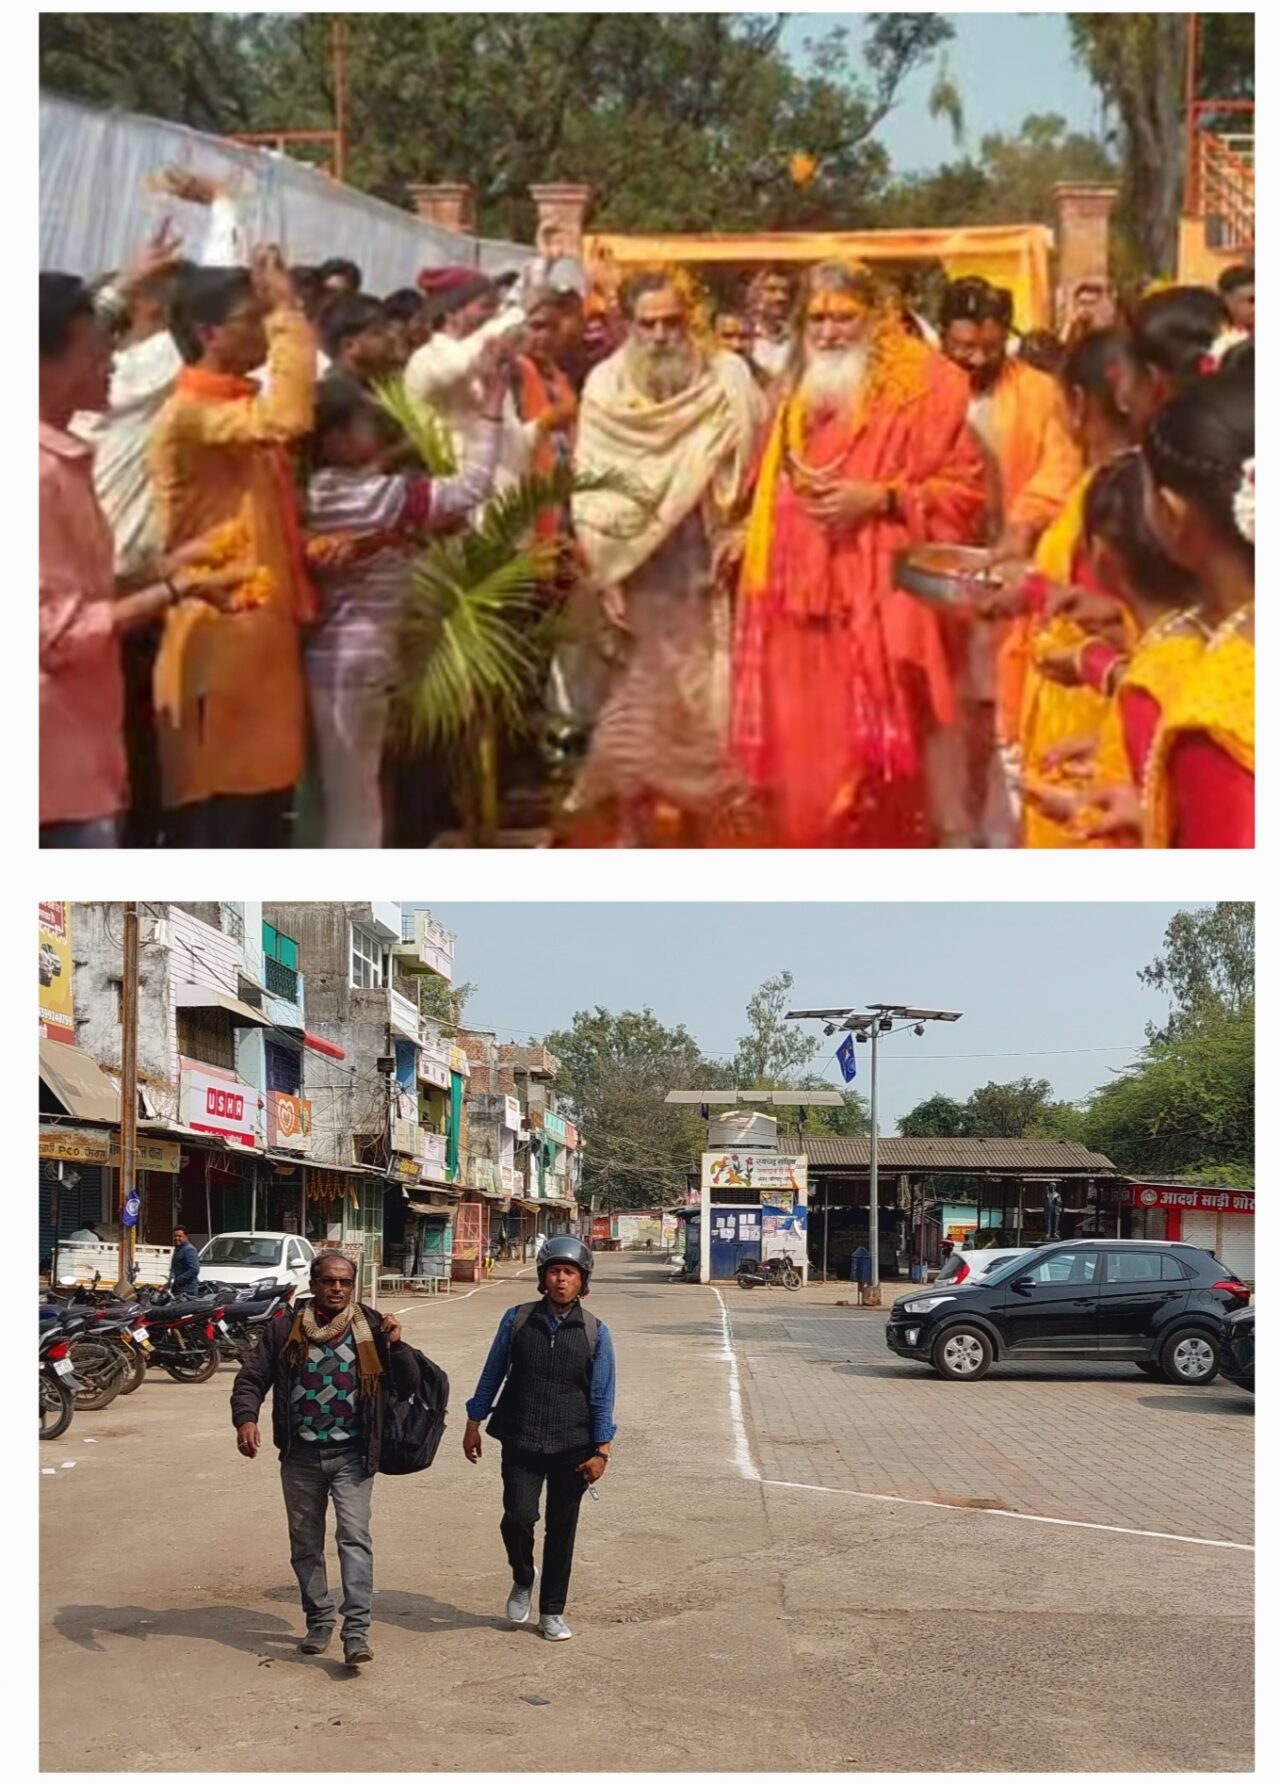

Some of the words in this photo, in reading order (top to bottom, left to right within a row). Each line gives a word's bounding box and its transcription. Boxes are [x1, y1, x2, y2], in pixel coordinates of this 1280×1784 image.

[207, 1090, 243, 1118] USHA
[58, 1145, 80, 1156] PCO
[1160, 1190, 1198, 1206] आदर्श
[1201, 1193, 1229, 1210] साड़ी
